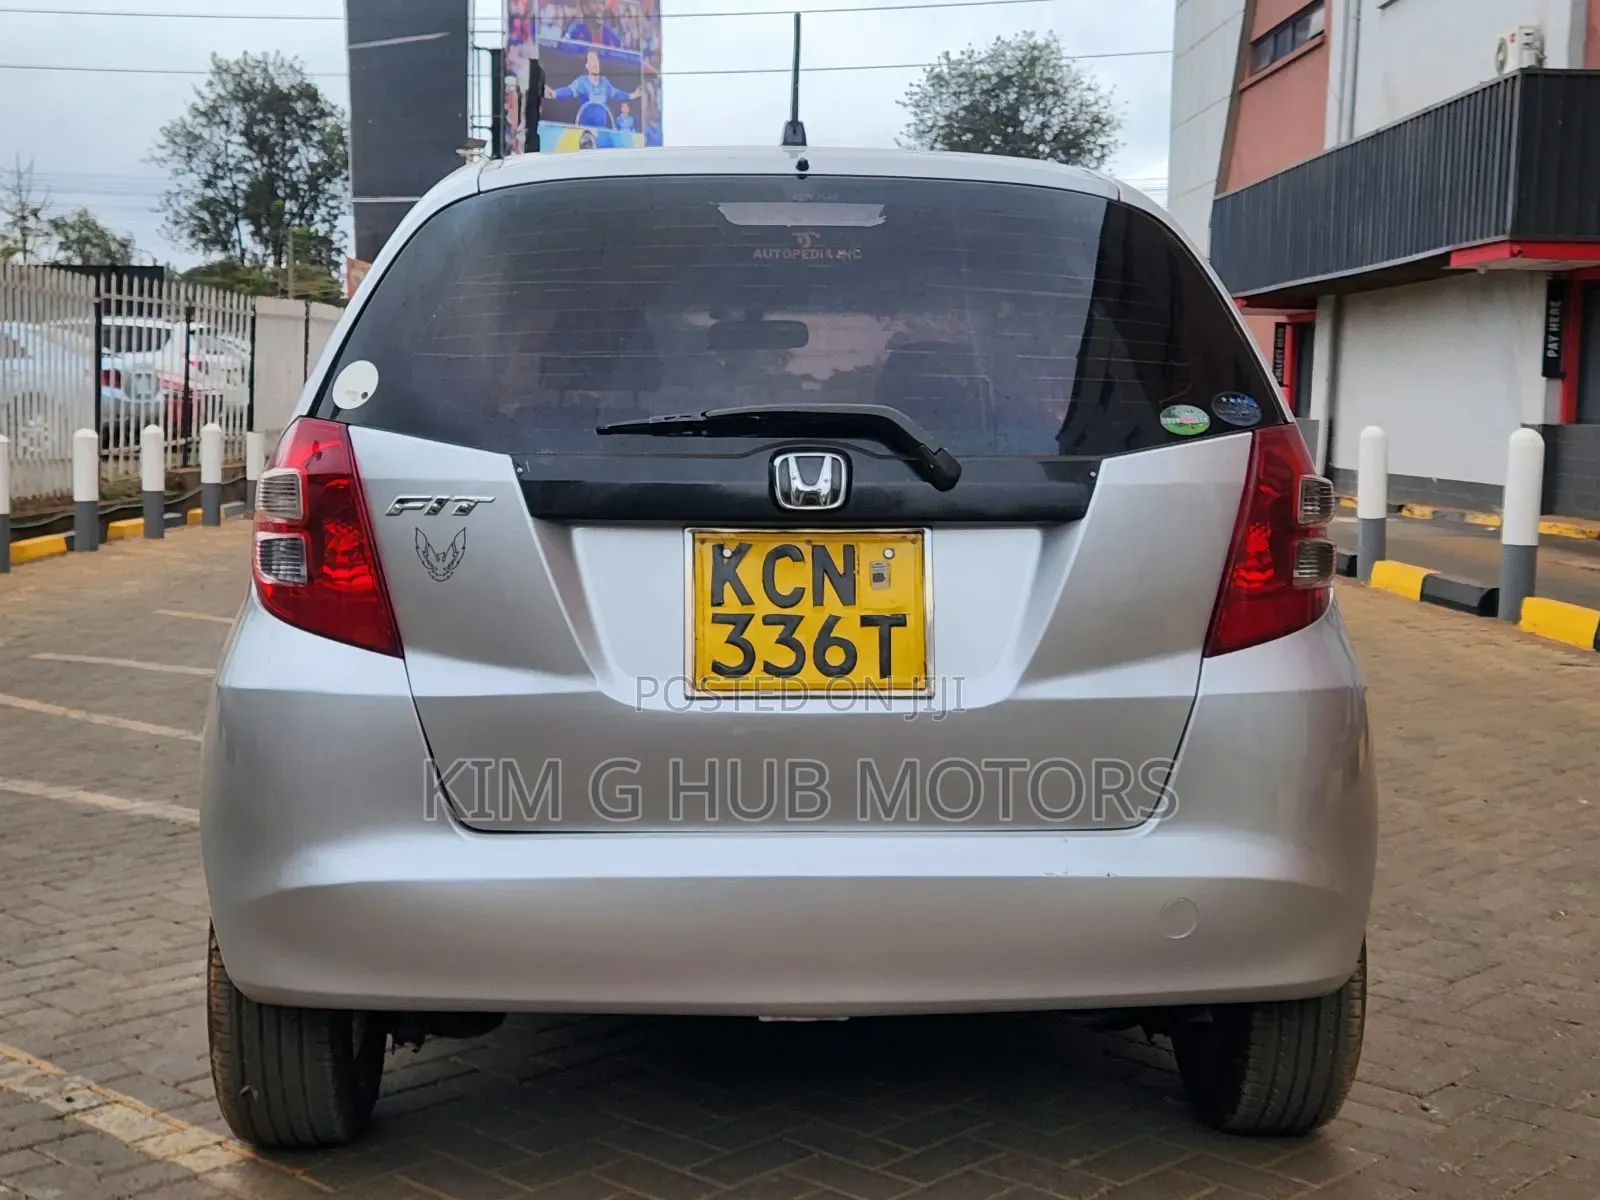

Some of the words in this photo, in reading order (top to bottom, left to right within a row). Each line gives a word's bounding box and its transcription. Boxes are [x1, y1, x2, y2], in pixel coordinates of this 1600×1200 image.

[753, 248, 834, 260] AUTOPEDIA
[1546, 335, 1560, 357] PAY
[385, 495, 496, 516] FIT
[710, 543, 856, 609] KCN
[711, 613, 908, 679] 336T
